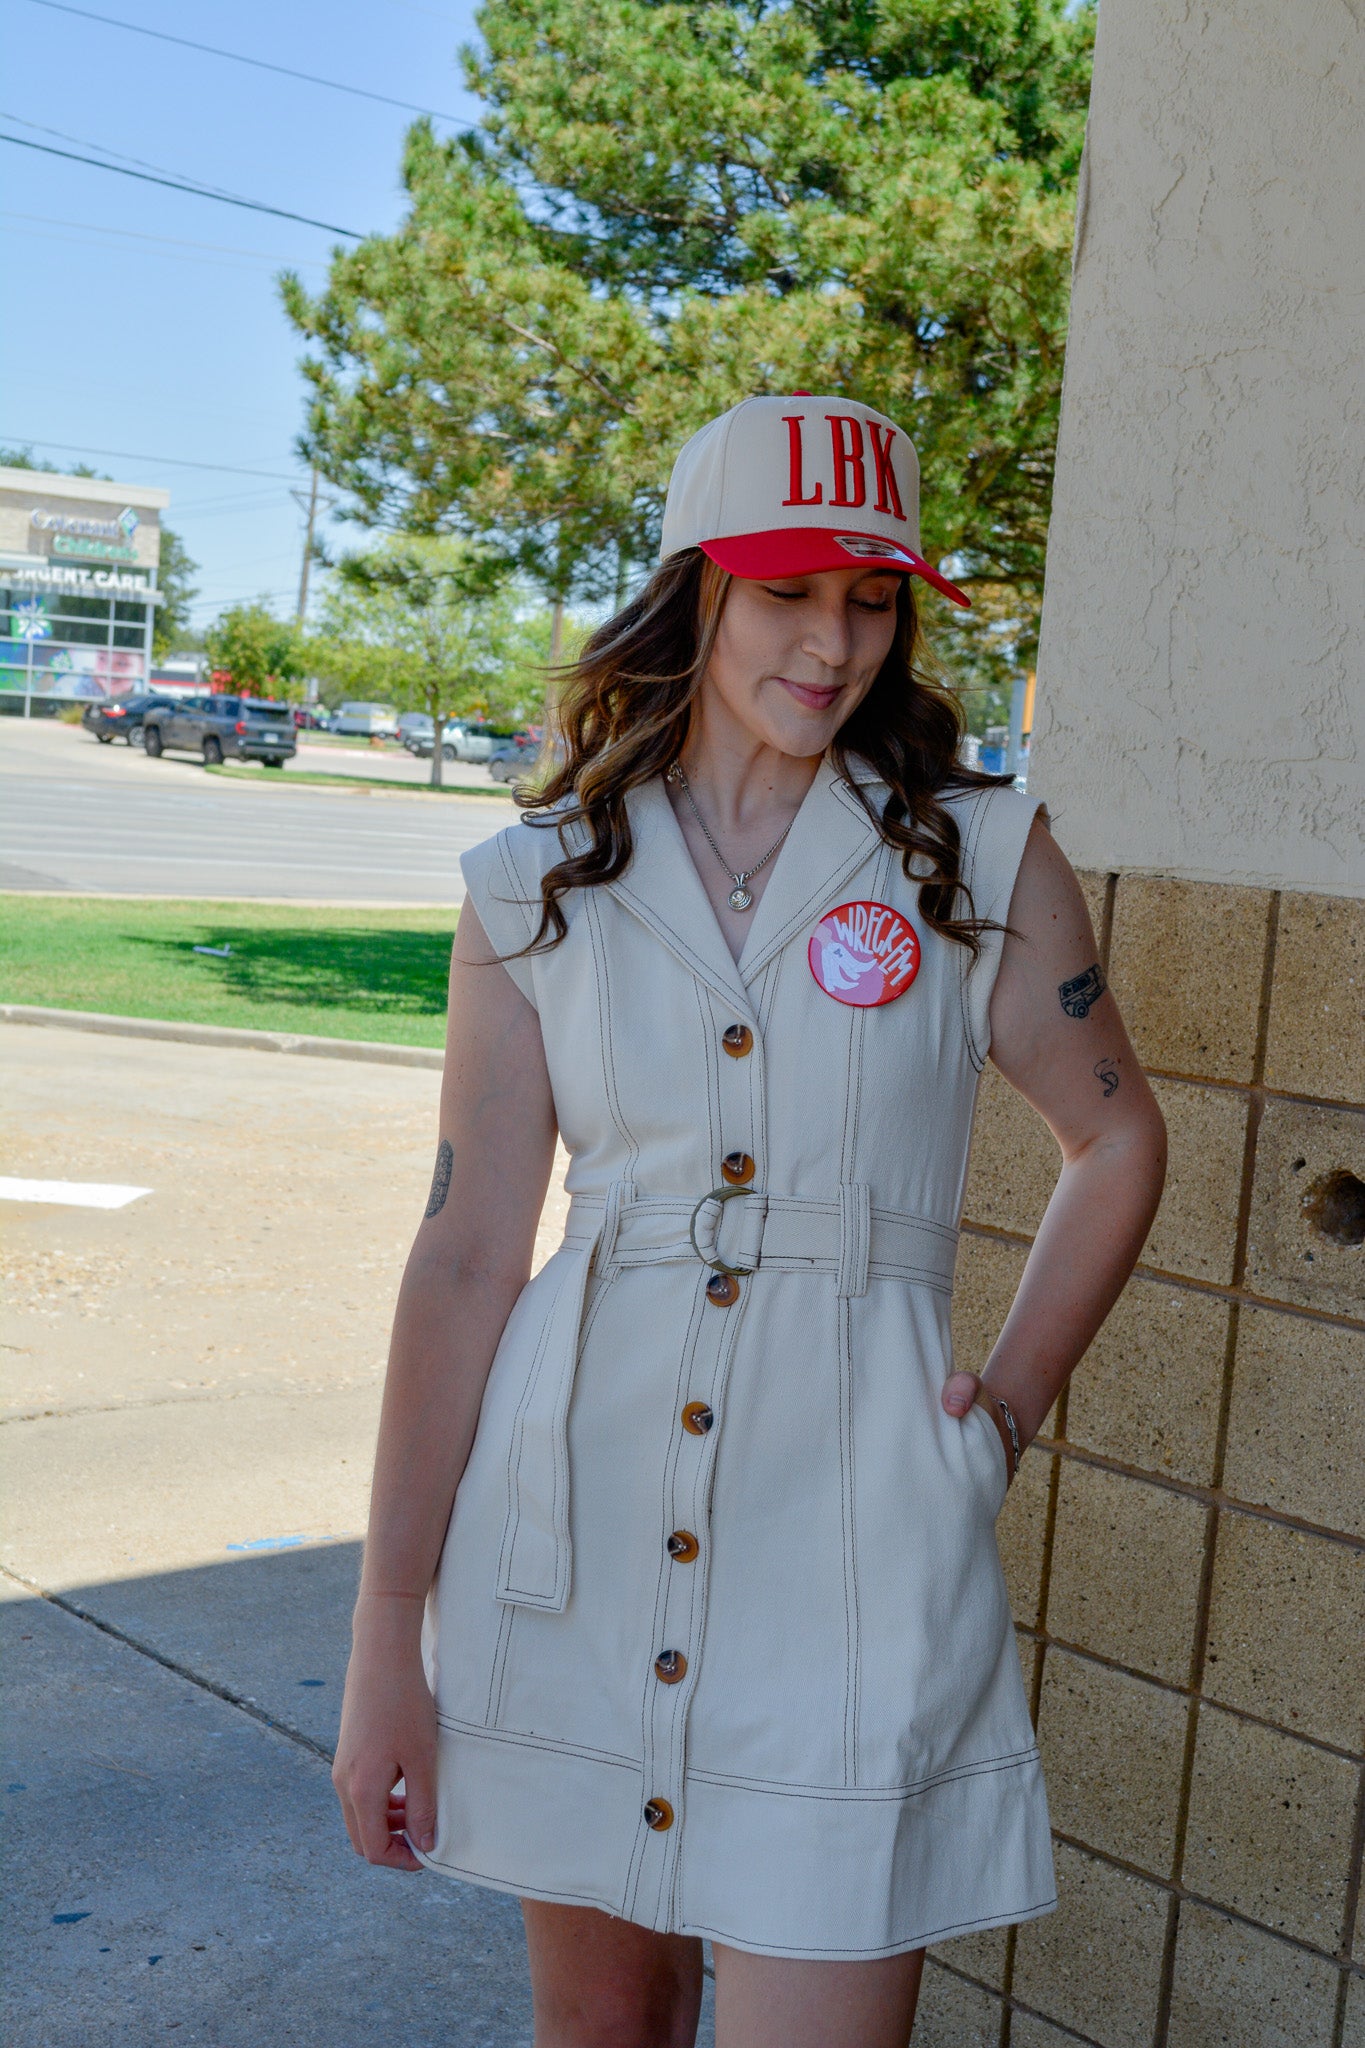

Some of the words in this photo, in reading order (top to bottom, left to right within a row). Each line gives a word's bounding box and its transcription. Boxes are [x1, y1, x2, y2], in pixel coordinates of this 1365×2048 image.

[781, 415, 907, 521] LBK
[93, 570, 148, 591] CARE
[832, 904, 904, 957] WRECK
